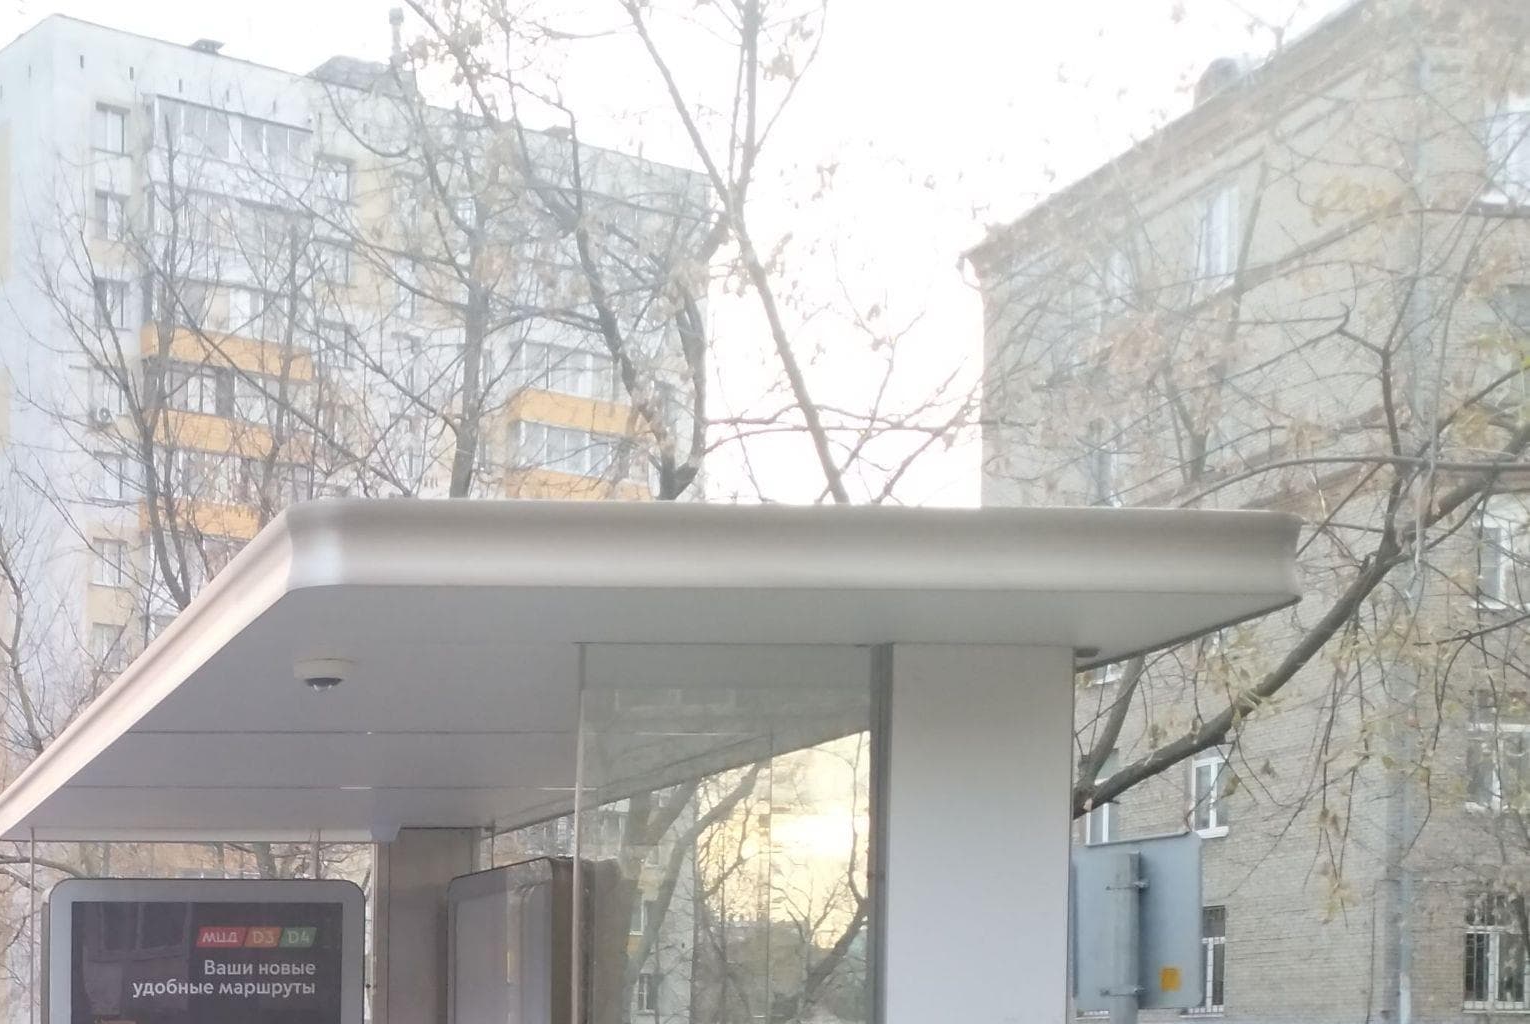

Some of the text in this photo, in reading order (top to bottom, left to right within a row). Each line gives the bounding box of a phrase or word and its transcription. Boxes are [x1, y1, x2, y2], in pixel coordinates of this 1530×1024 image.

[253, 931, 274, 944] D3
[288, 931, 310, 944] D4
[204, 959, 316, 975] Ваши новые
[132, 979, 316, 998] удобные маршруты
